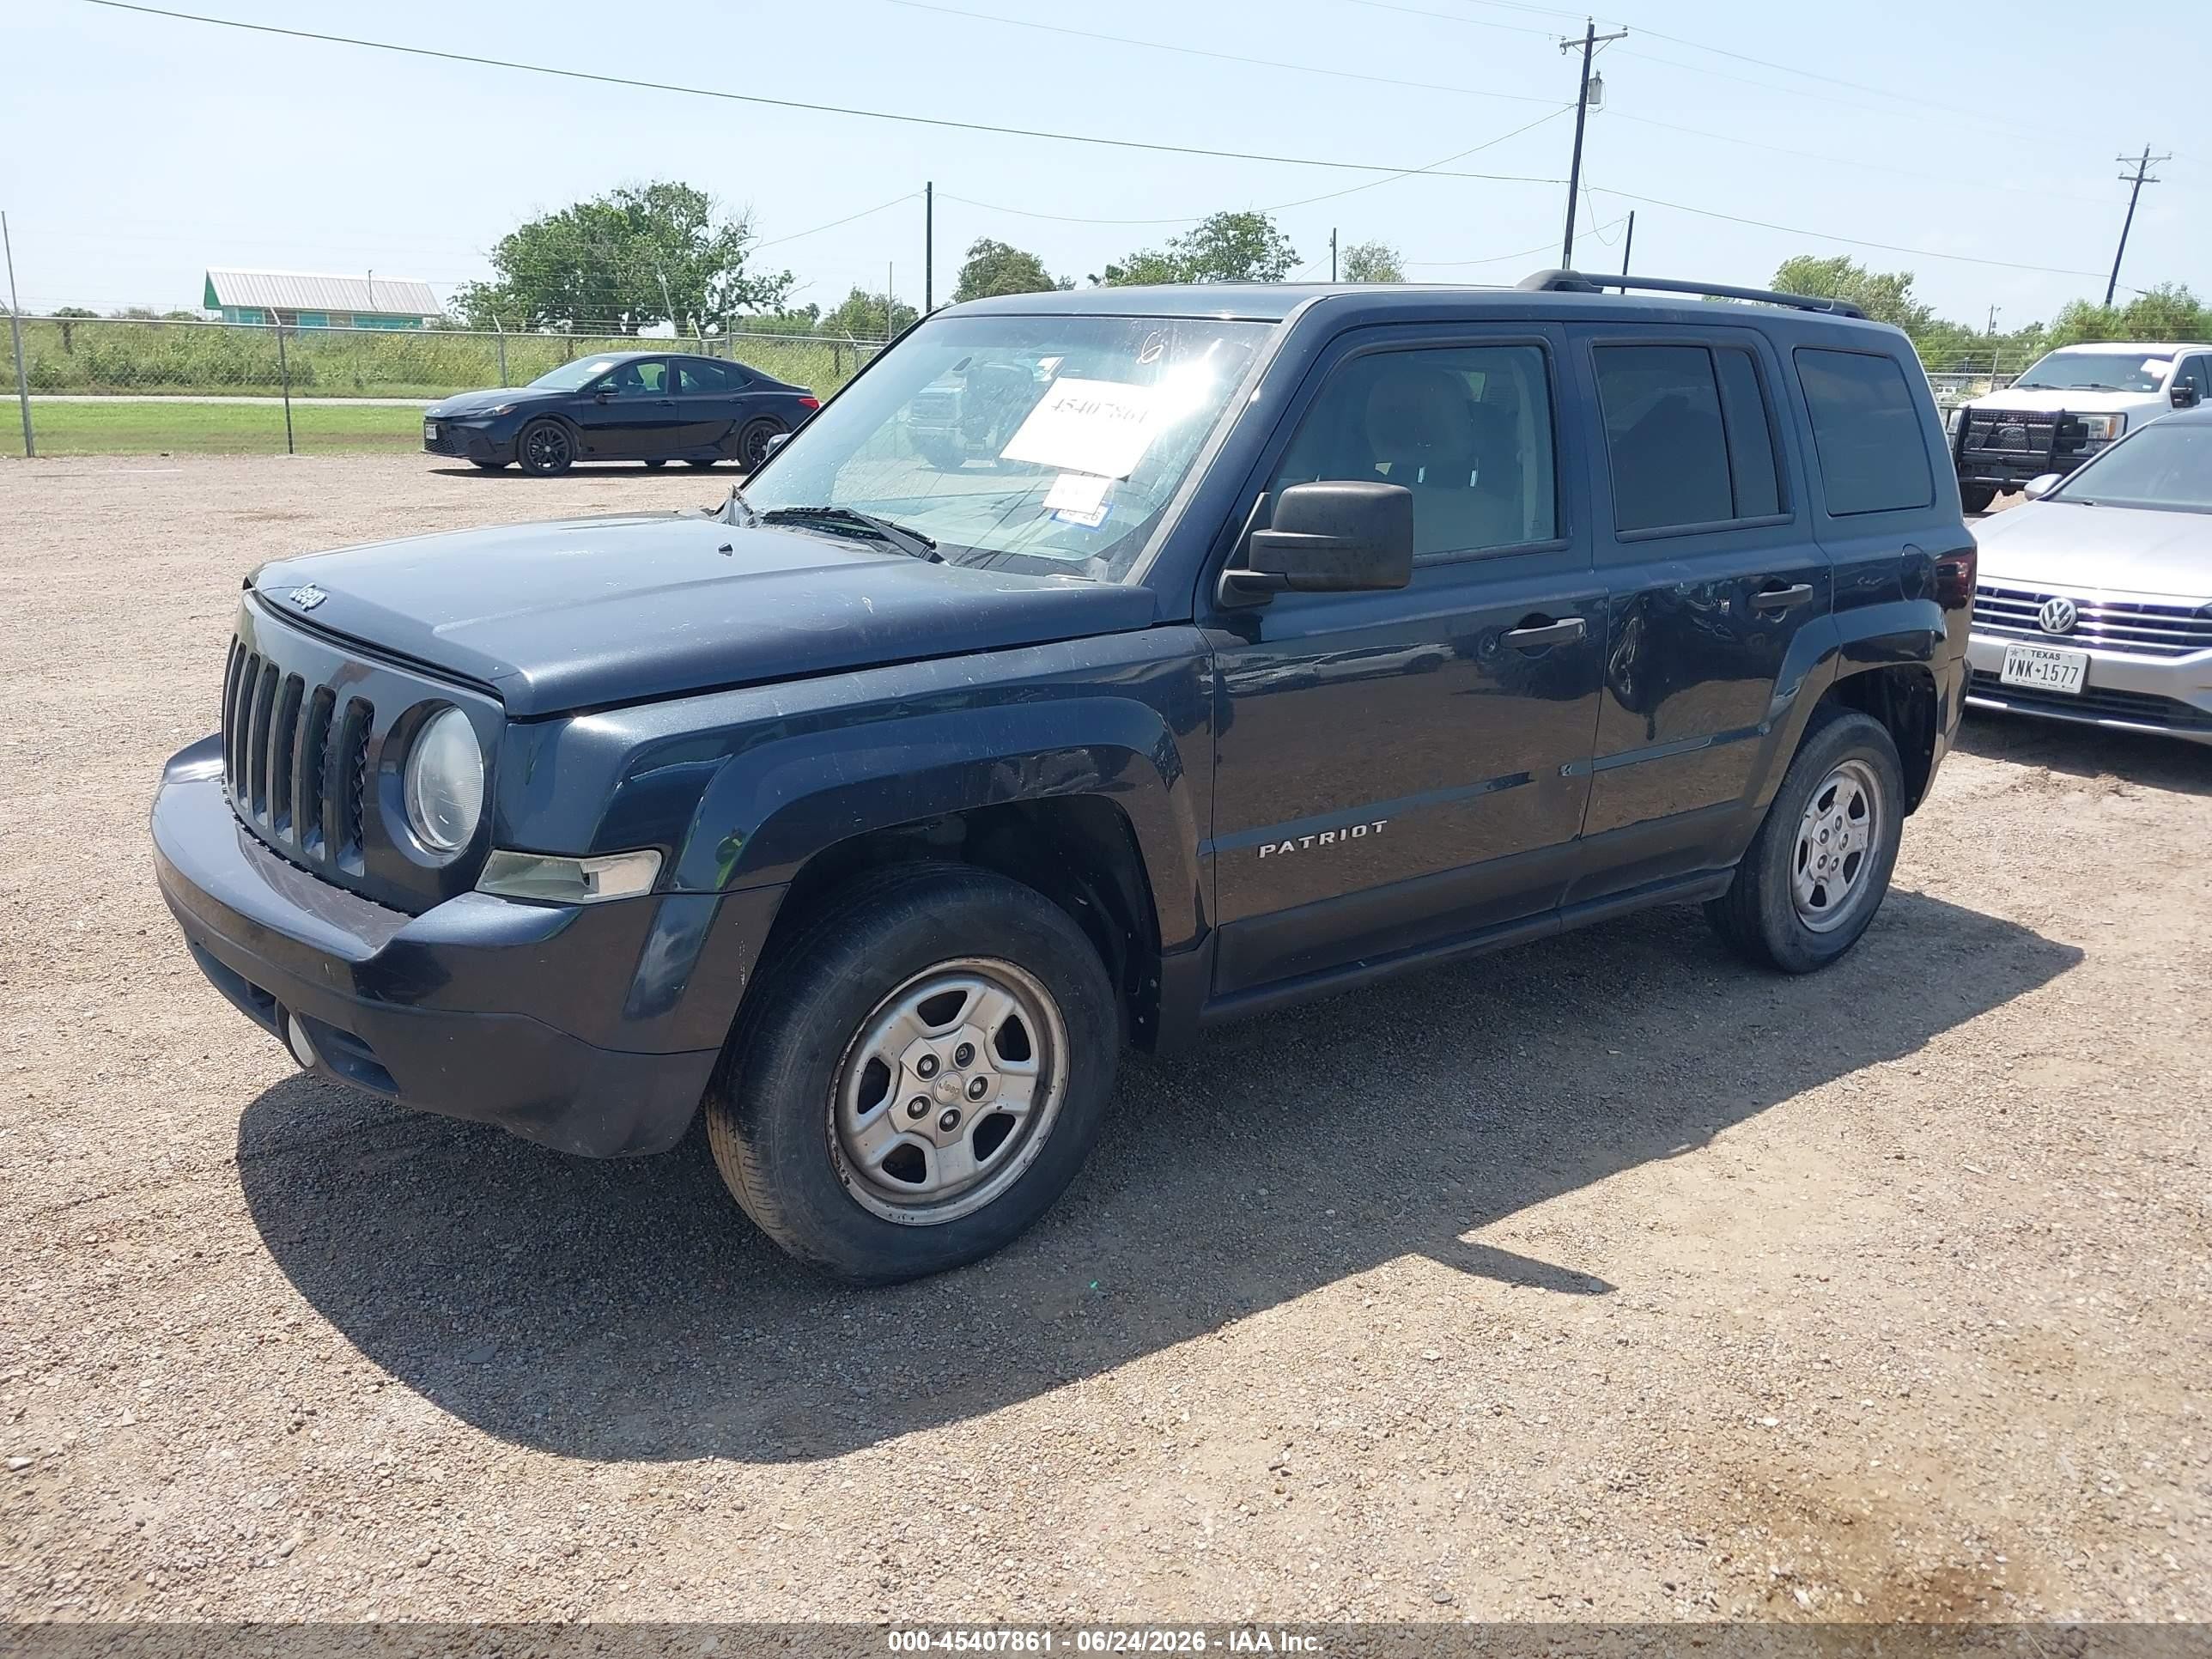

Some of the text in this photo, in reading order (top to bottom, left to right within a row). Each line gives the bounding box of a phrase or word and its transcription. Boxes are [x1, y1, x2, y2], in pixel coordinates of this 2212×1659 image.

[289, 582, 327, 610] Jeep
[2031, 650, 2060, 660] TEXAS
[1258, 819, 1388, 859] PATRIOT
